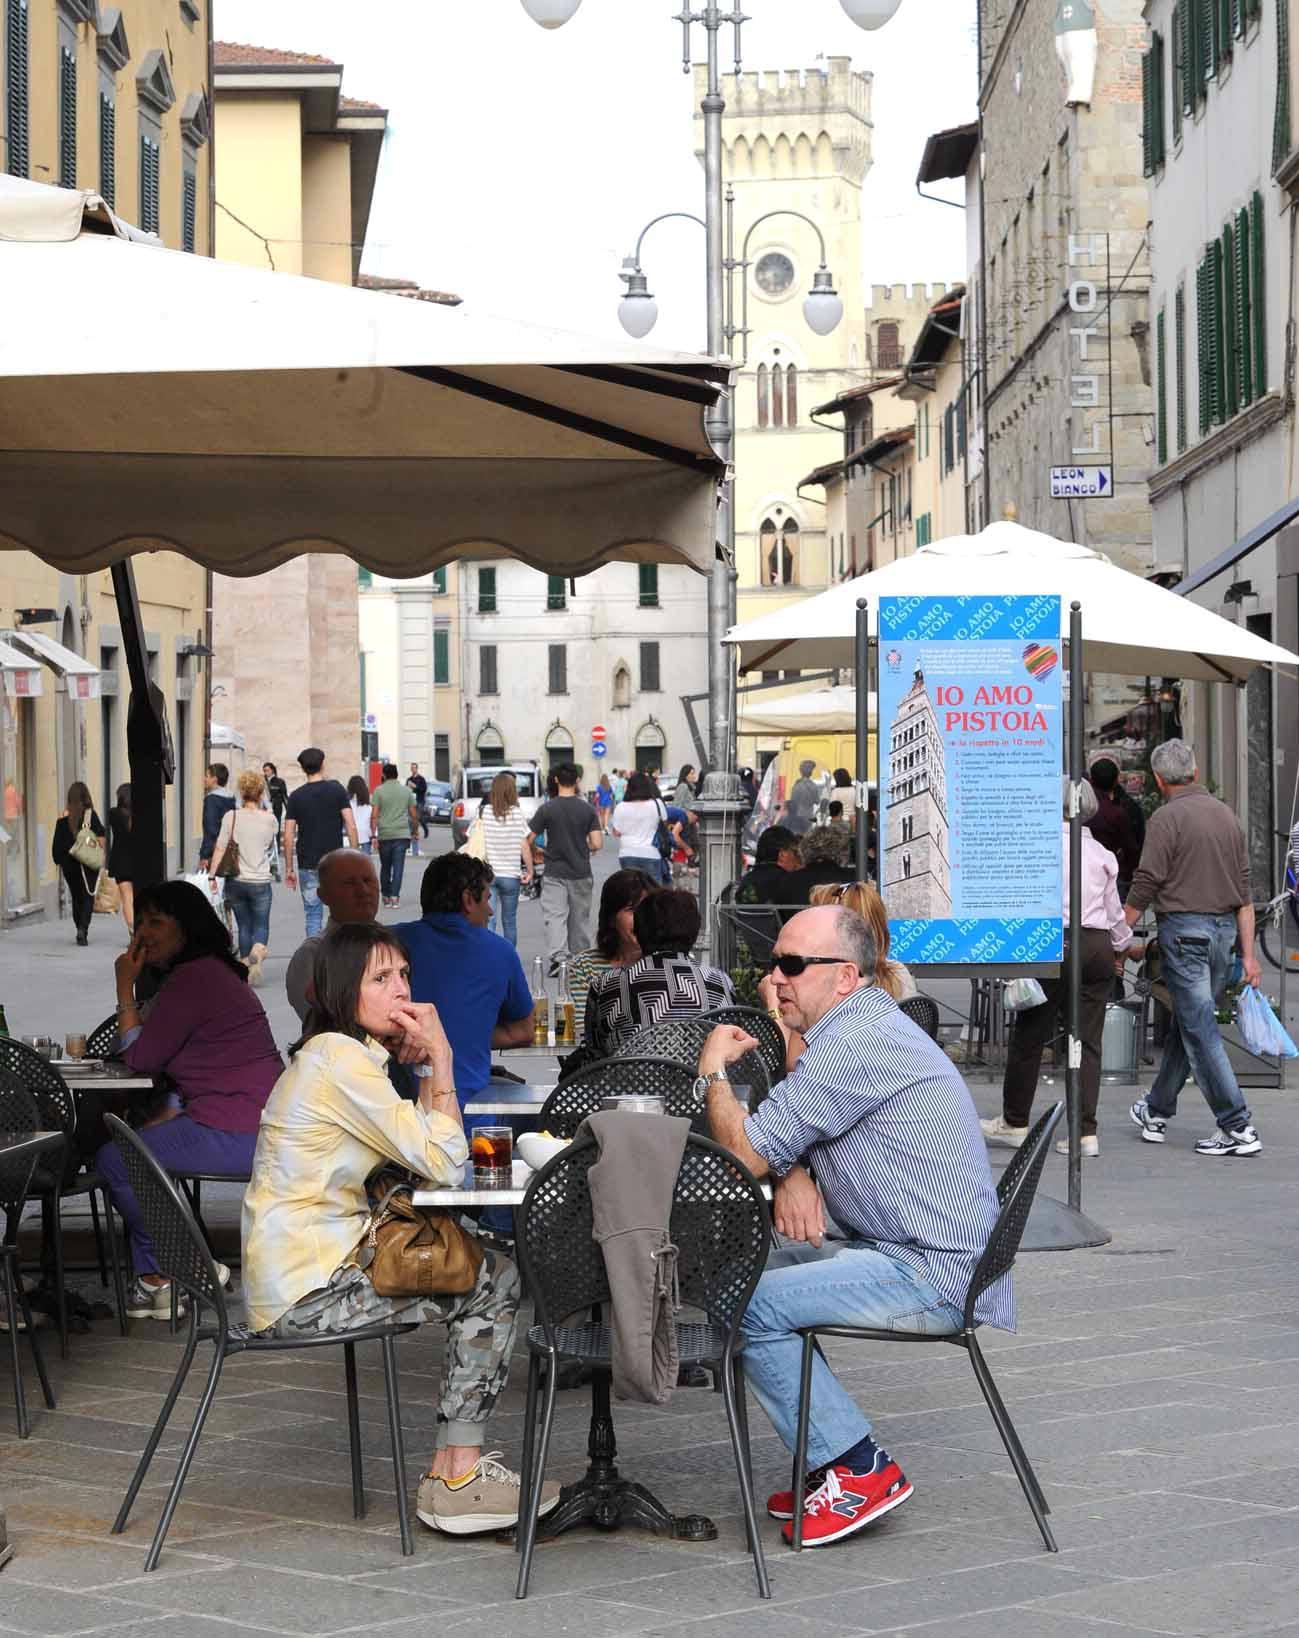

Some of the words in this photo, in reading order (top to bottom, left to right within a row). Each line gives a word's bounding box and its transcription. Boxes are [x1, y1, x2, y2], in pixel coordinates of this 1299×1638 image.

[1052, 469, 1084, 479] LEON
[1053, 485, 1097, 495] BIANCO
[881, 605, 896, 621] IO
[888, 596, 925, 630] PISTO
[917, 603, 943, 630] AMO
[919, 610, 953, 640] STOIA
[967, 609, 1004, 640] STOIA
[968, 602, 993, 630] AMO
[1009, 616, 1024, 631] IO
[1016, 598, 1059, 640] PISTOIA
[935, 686, 964, 705] IO
[973, 685, 1033, 705] AMO
[945, 711, 1048, 732] PISTOIA
[920, 933, 945, 960] AMO
[970, 931, 995, 958] AMO
[1011, 945, 1026, 960] IO
[1026, 919, 1052, 946] AMO
[831, 1491, 867, 1518] N
